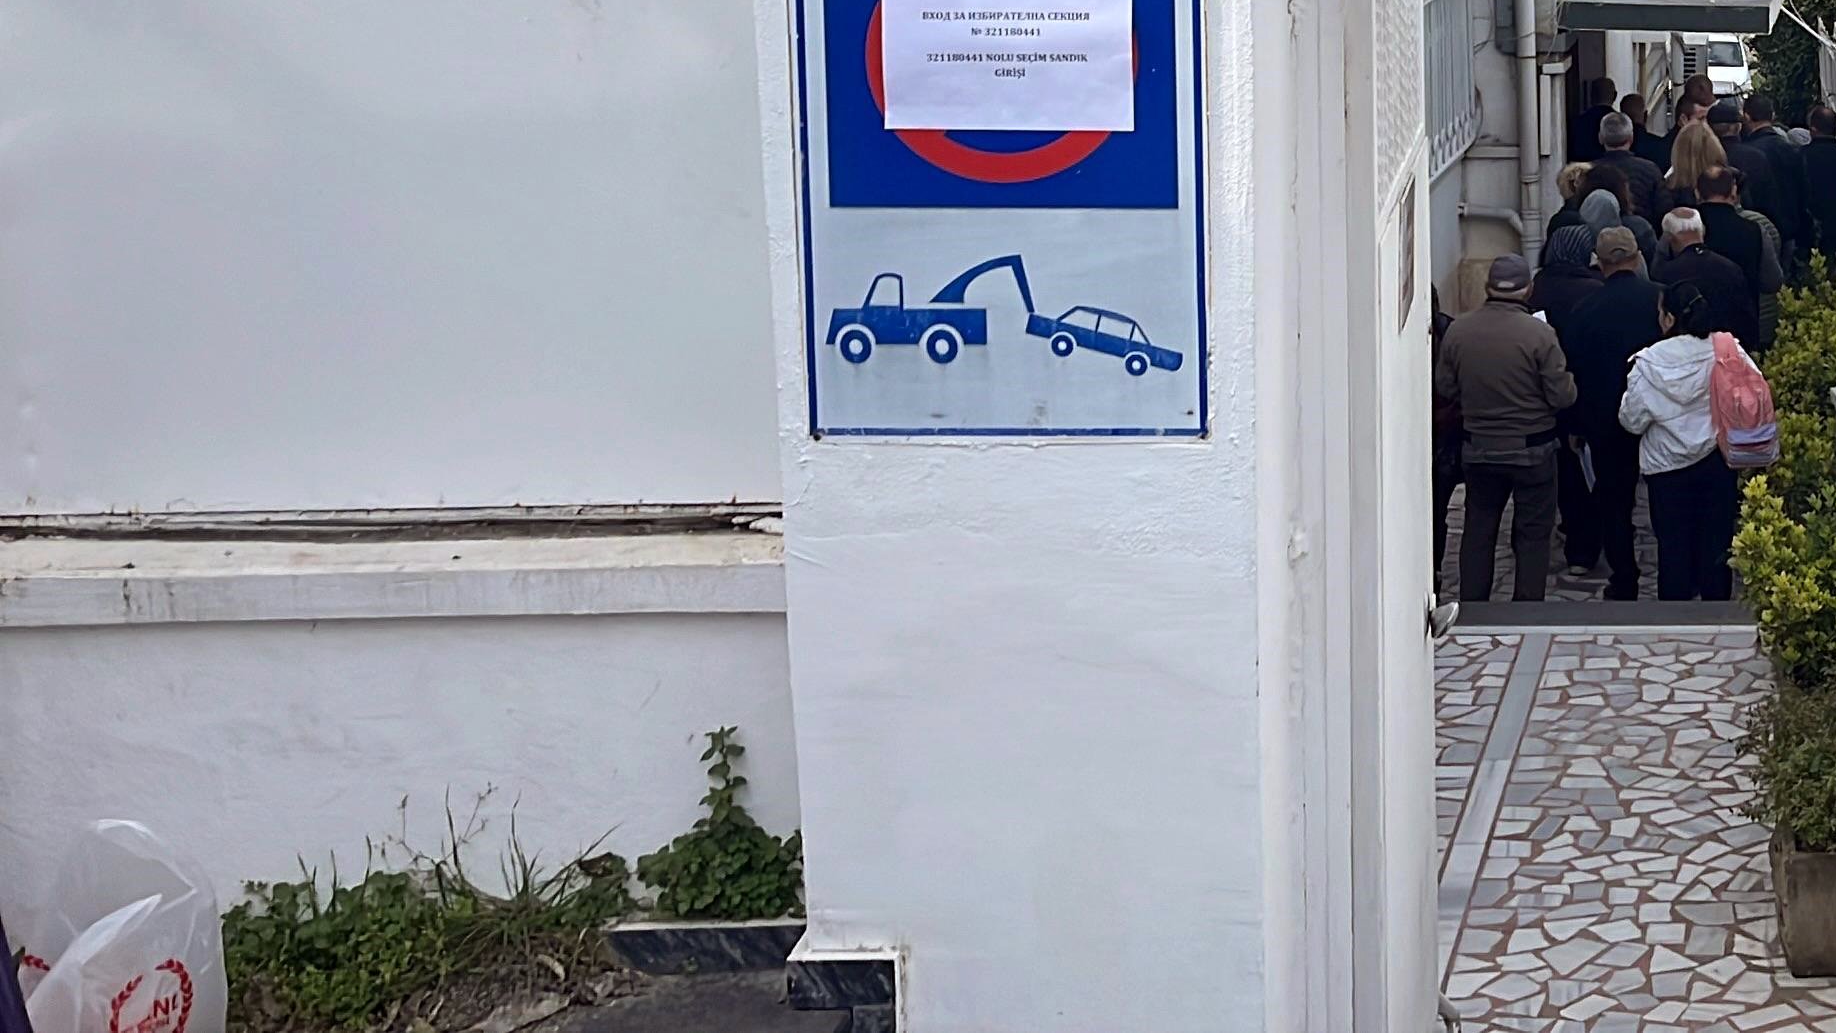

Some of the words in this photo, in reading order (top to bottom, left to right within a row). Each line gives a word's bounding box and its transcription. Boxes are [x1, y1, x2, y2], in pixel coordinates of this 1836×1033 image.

[922, 11, 952, 21] ВХОД
[952, 11, 966, 21] ЗА
[968, 11, 1046, 21] ИЗБИРАТЕЛНА
[1047, 11, 1090, 22] СЕКЦИЯ
[984, 27, 1041, 37] 321180441
[926, 52, 983, 63] 321180441
[985, 52, 1015, 63] NOLU
[1016, 50, 1047, 65] SEÇİM
[1048, 52, 1089, 63] SANDIK
